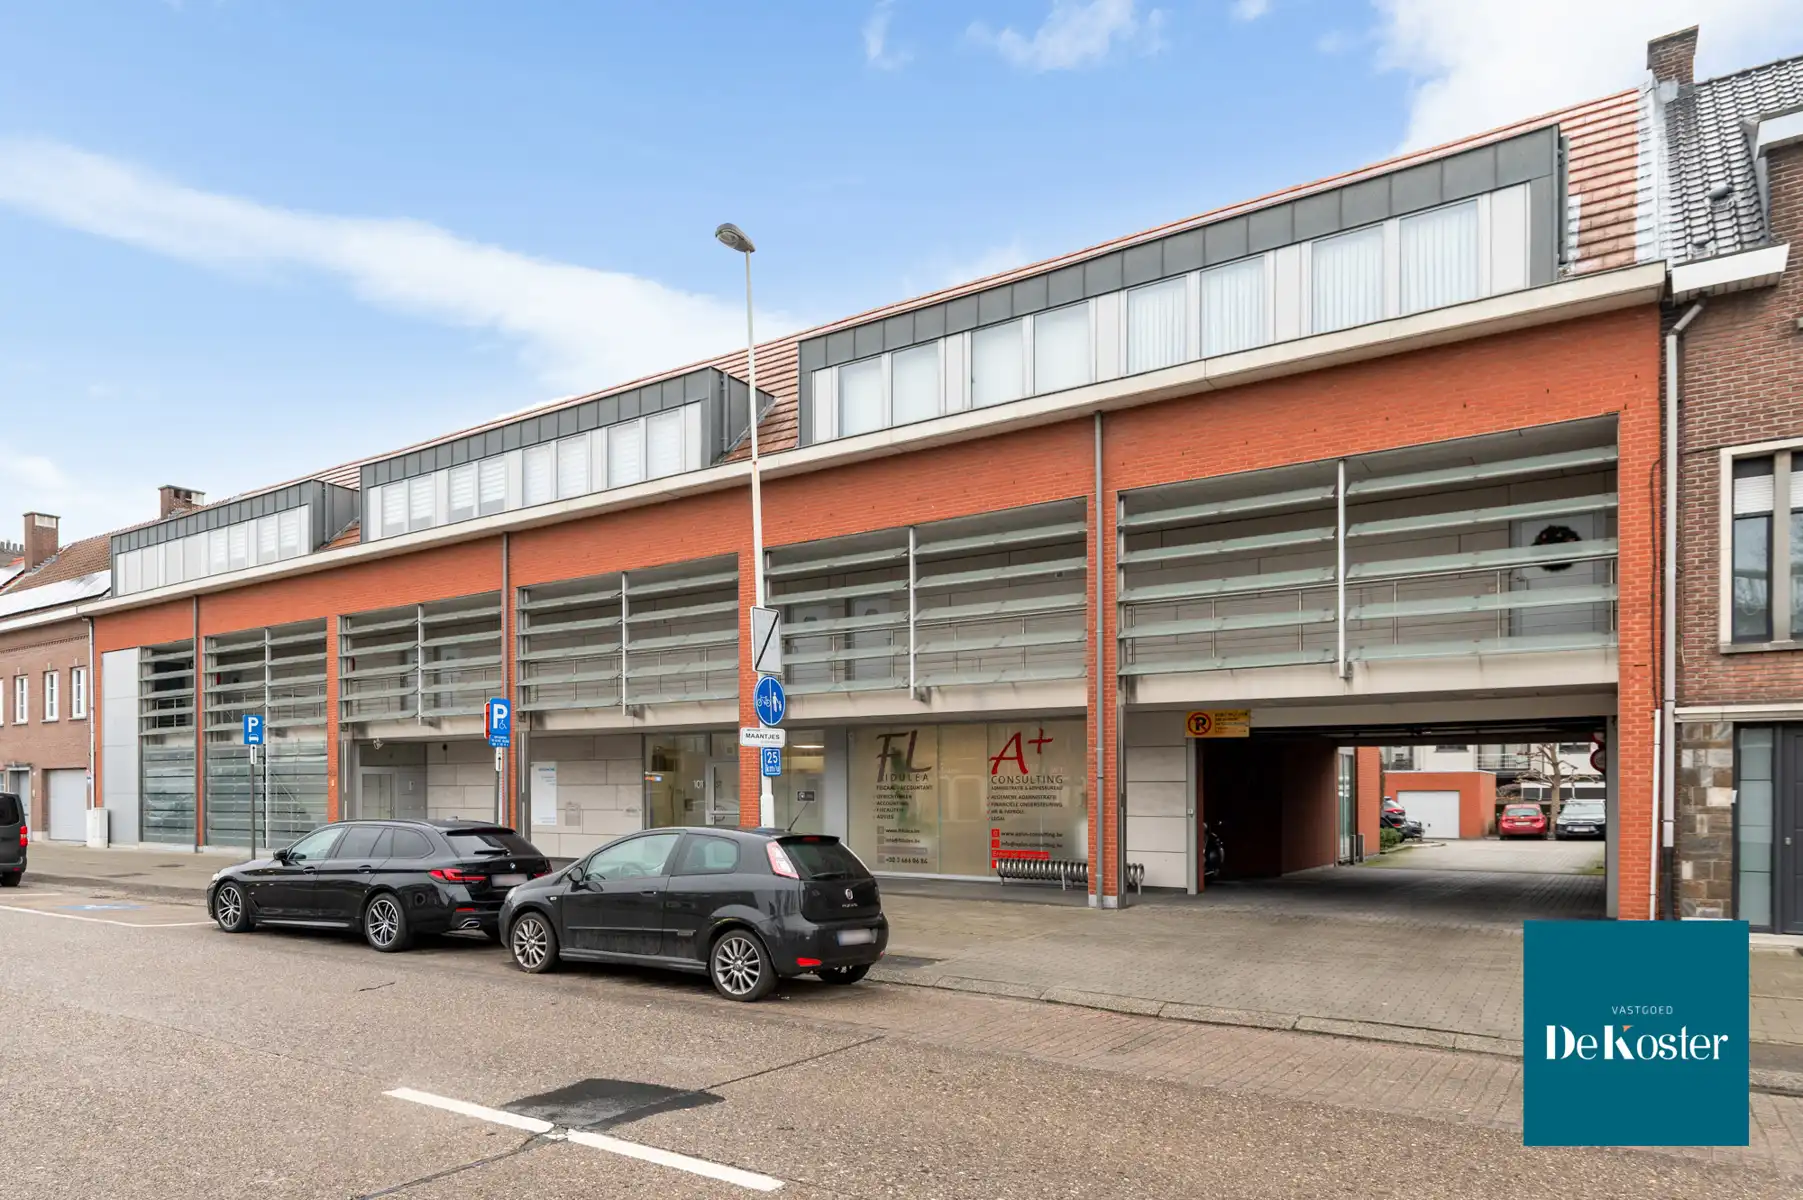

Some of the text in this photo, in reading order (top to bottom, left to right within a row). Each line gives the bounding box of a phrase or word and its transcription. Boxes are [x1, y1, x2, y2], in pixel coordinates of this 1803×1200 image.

[493, 703, 508, 729] P
[248, 716, 259, 733] P
[745, 732, 780, 740] MAANTJES
[766, 751, 779, 764] 25
[989, 727, 1053, 775] A+
[991, 774, 1063, 784] CONSULTING
